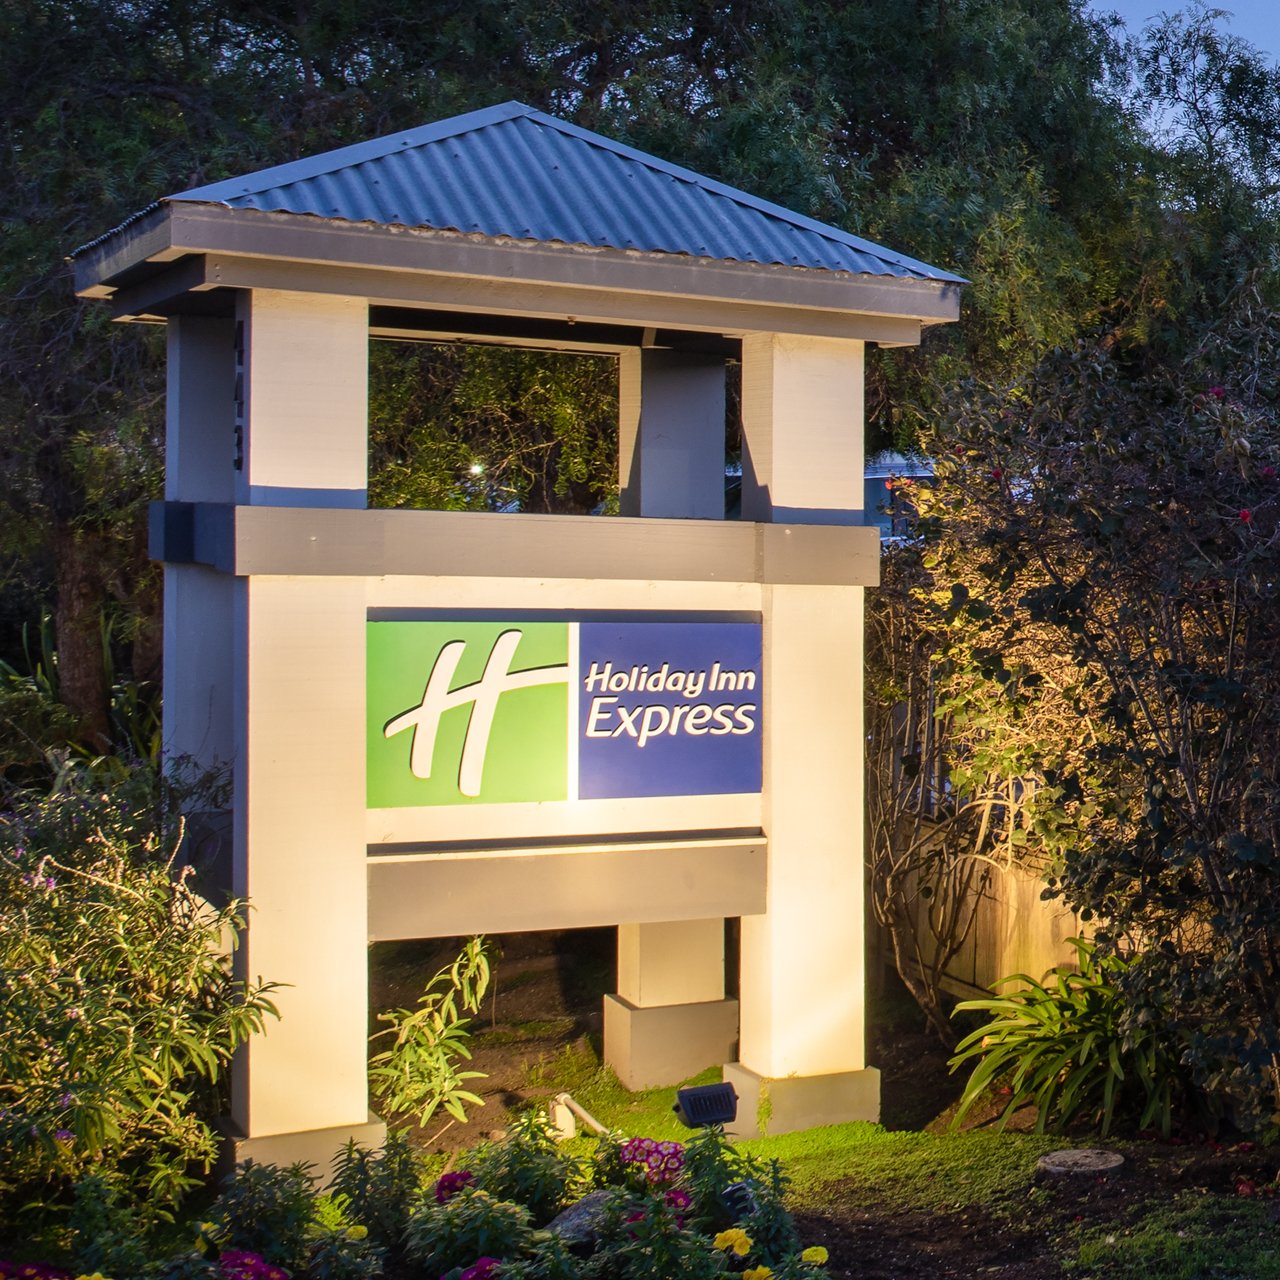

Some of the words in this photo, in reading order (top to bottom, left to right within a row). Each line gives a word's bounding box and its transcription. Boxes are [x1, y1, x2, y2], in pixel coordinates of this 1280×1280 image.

[584, 661, 705, 698] Holiday
[708, 662, 756, 692] Inn
[585, 695, 756, 748] Express
